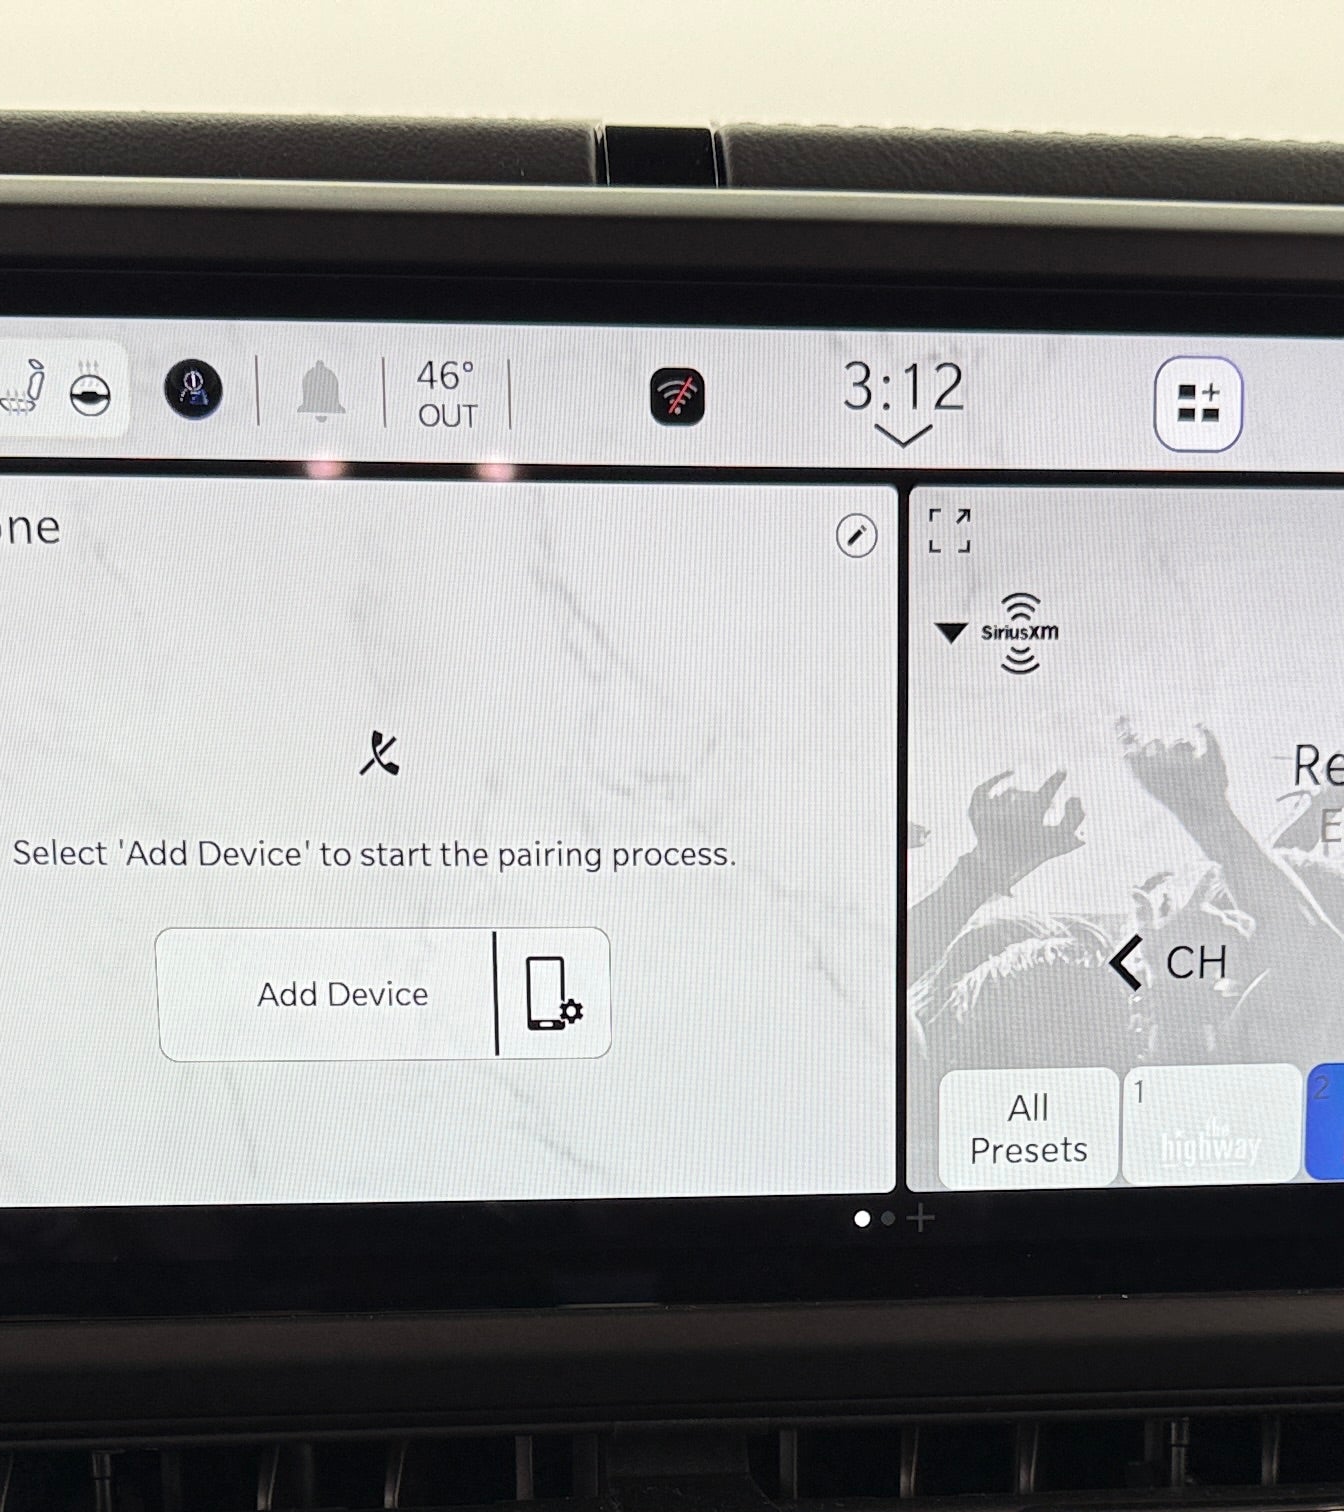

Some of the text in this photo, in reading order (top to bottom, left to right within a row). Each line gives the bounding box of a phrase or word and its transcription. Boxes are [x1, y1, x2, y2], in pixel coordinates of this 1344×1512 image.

[416, 360, 475, 391] 46°
[843, 360, 965, 412] 3:12
[418, 402, 478, 429] OUT
[13, 838, 737, 873] Select 'Add Device' to start the pairing process.
[1167, 944, 1228, 980] CH
[257, 980, 429, 1008] Add Device
[1007, 1092, 1049, 1122] All
[1133, 1079, 1145, 1104] 1
[971, 1135, 1089, 1166] Presets
